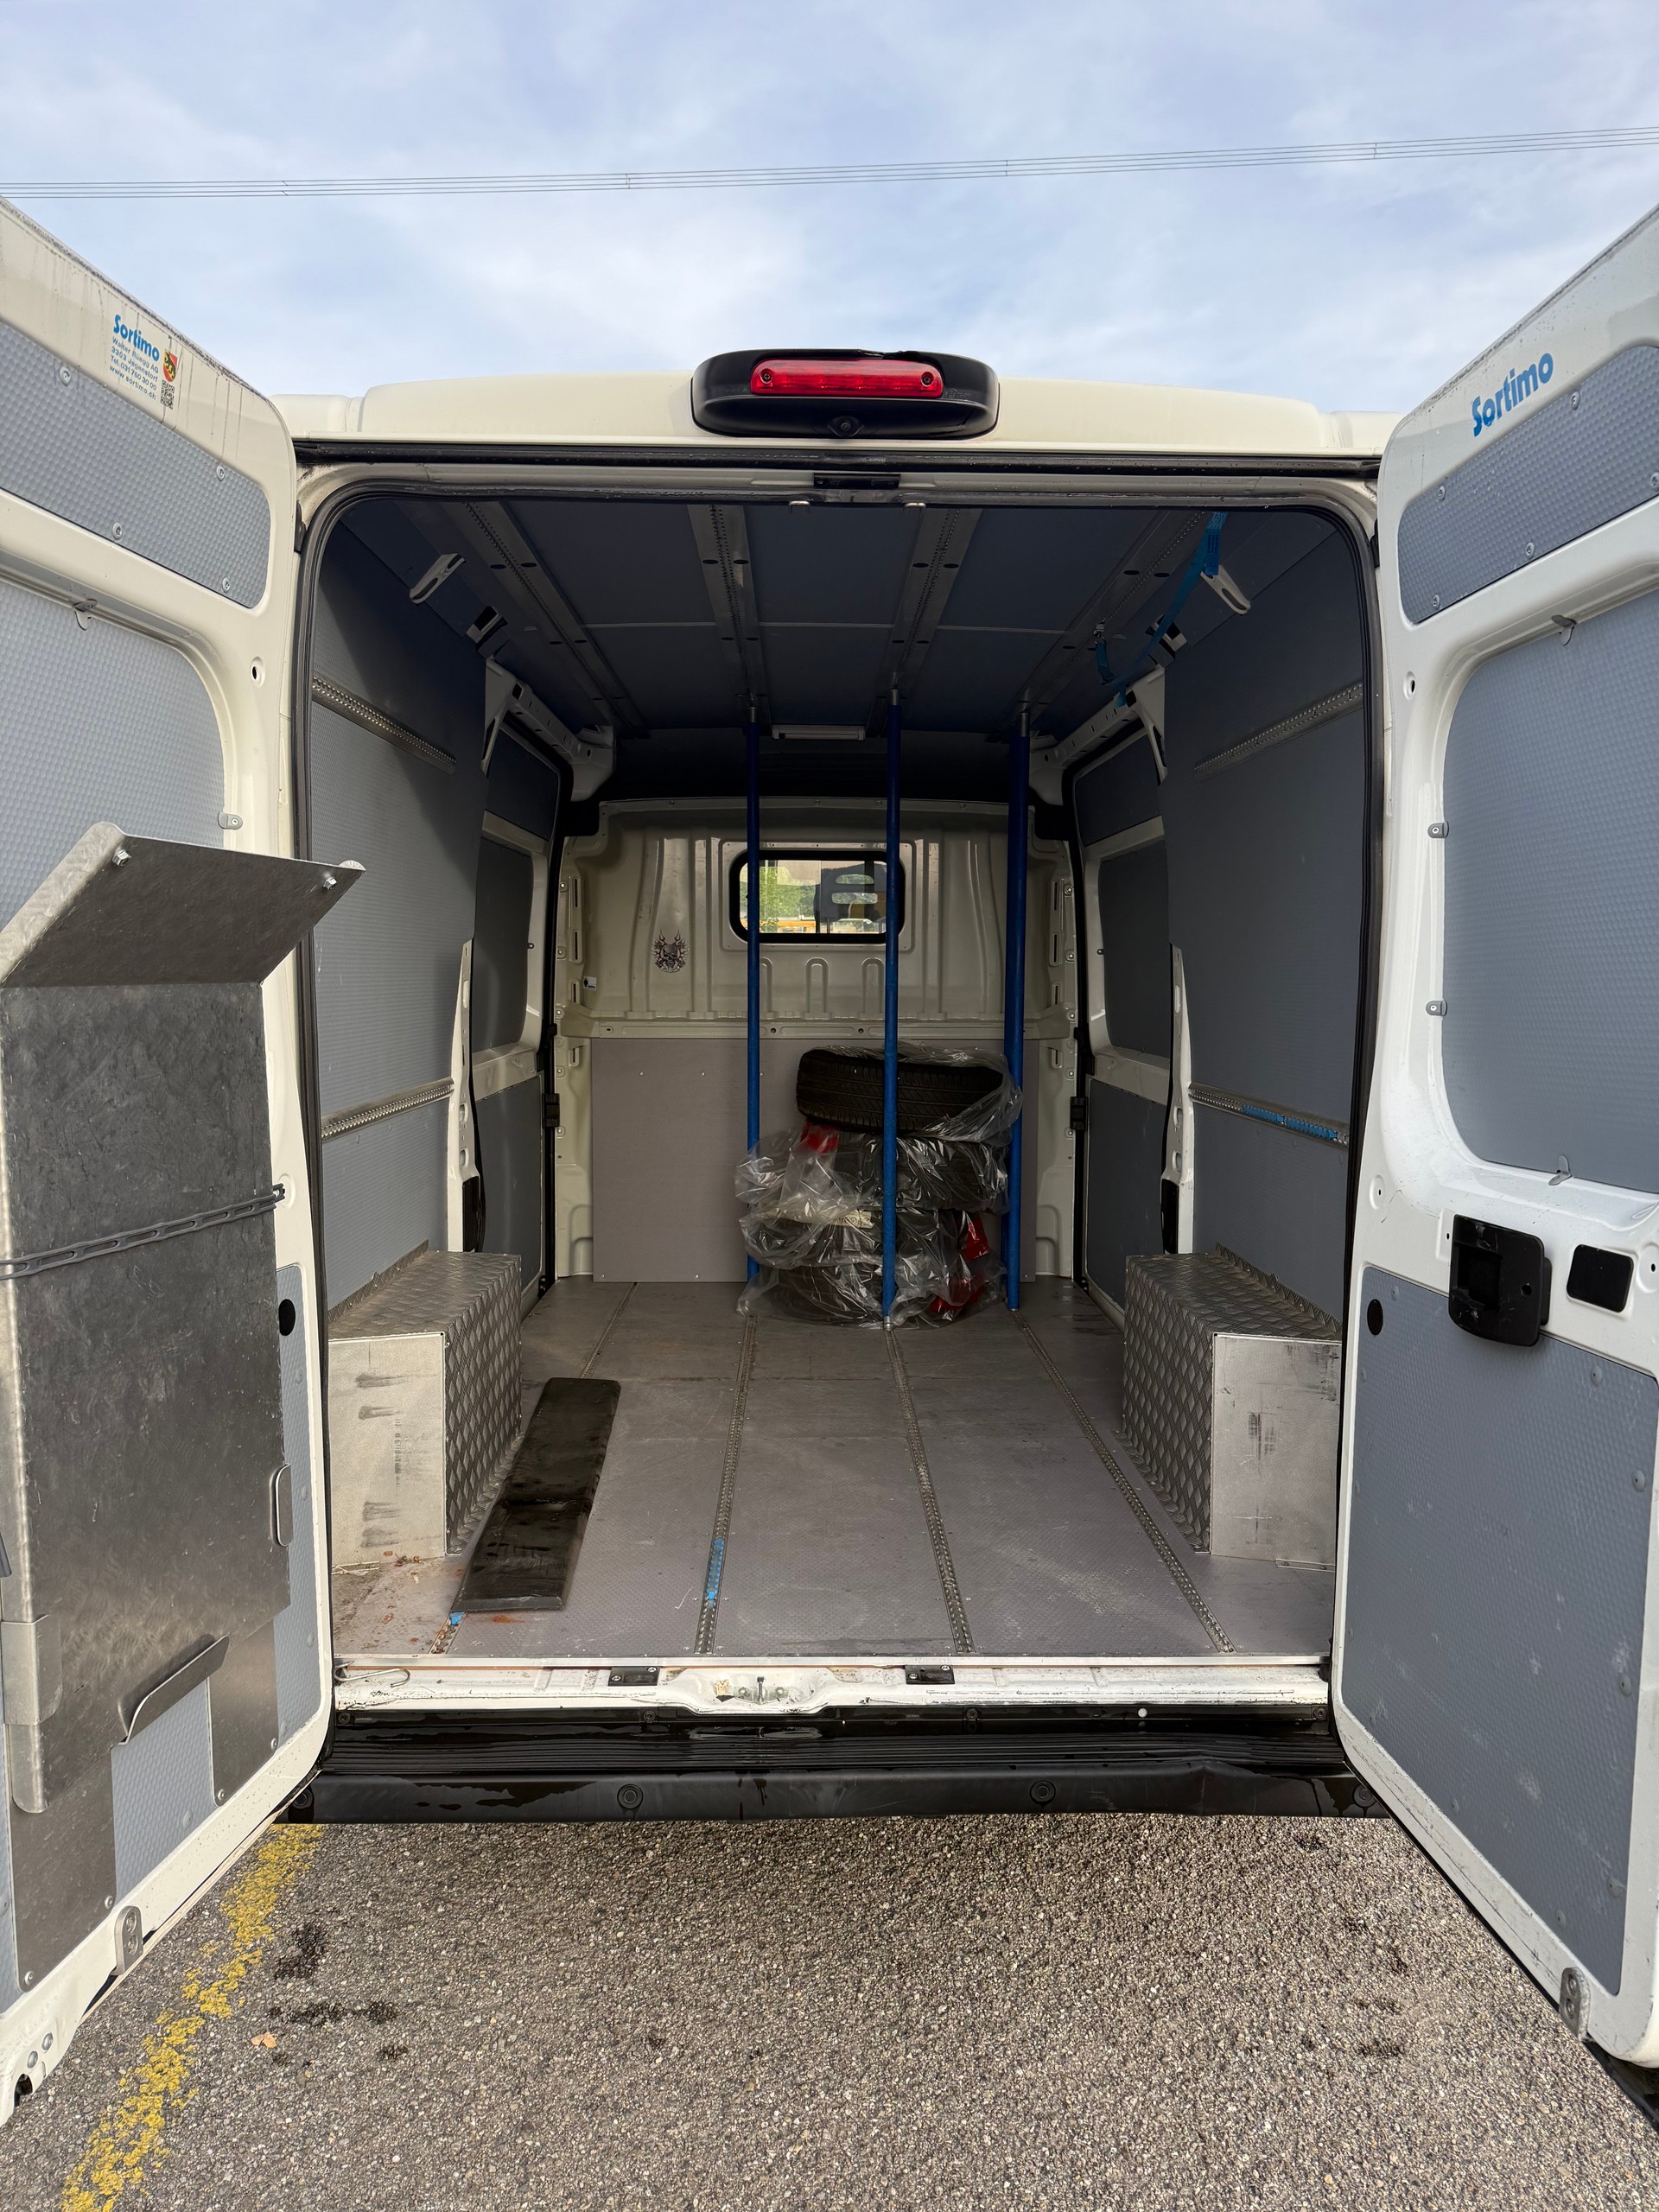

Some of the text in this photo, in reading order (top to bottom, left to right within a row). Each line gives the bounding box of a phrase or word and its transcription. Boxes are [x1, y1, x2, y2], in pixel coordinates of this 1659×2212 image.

[112, 337, 130, 353] Walter
[150, 364, 159, 373] AG
[113, 314, 160, 361] Sortimo
[109, 365, 156, 399] wwwsortimo.ch
[128, 359, 158, 382] Jegenstorf
[1471, 353, 1554, 437] Sortimo
